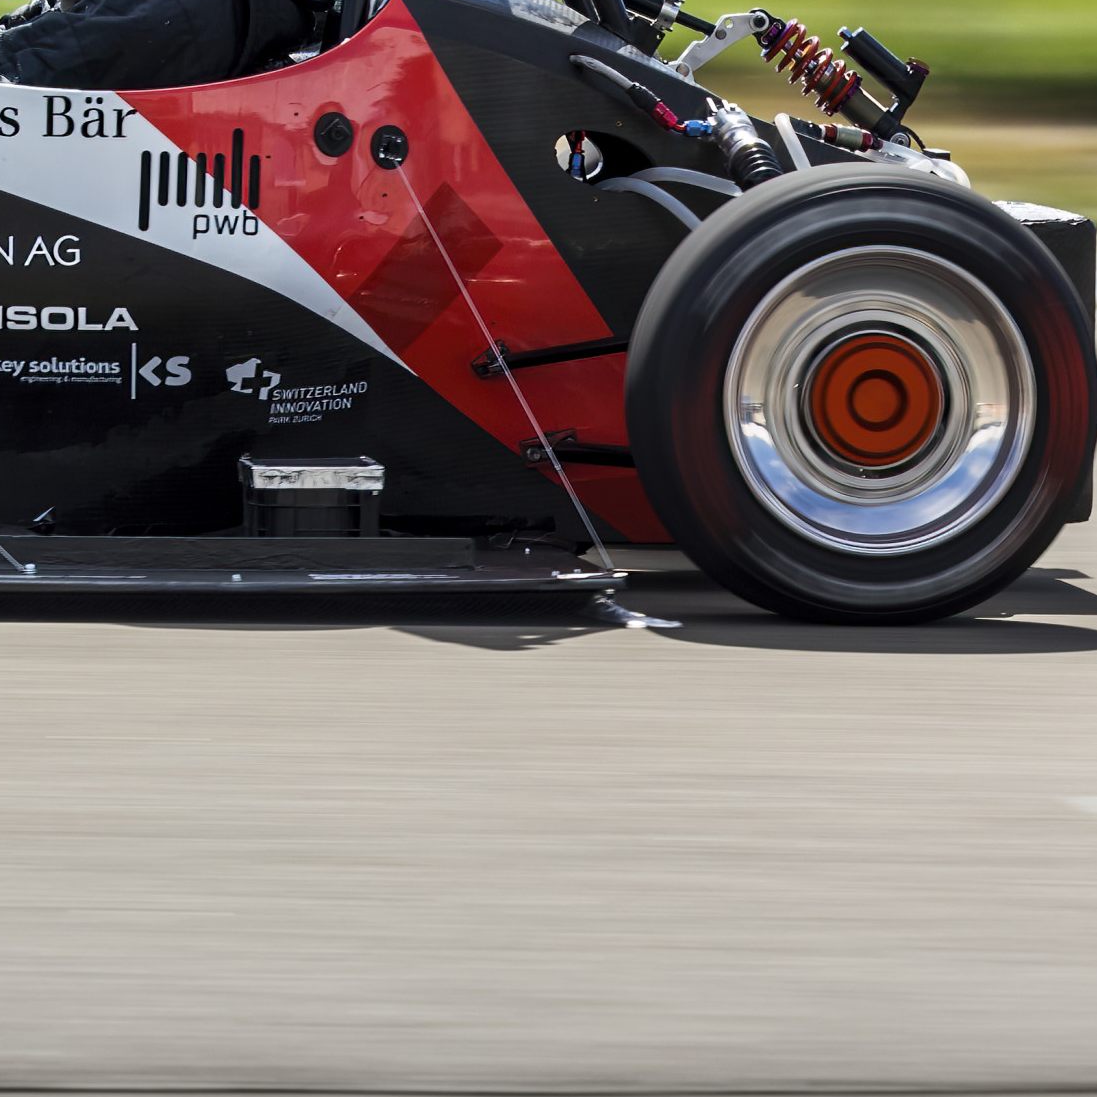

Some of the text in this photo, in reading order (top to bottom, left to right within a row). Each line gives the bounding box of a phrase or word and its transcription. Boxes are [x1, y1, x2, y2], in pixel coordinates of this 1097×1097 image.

[42, 94, 138, 139] Bär
[192, 209, 259, 240] pwb
[24, 235, 82, 267] AG
[29, 357, 121, 375] solutions
[272, 381, 368, 401] SWITZERLAND
[269, 397, 353, 415] INNOVATION
